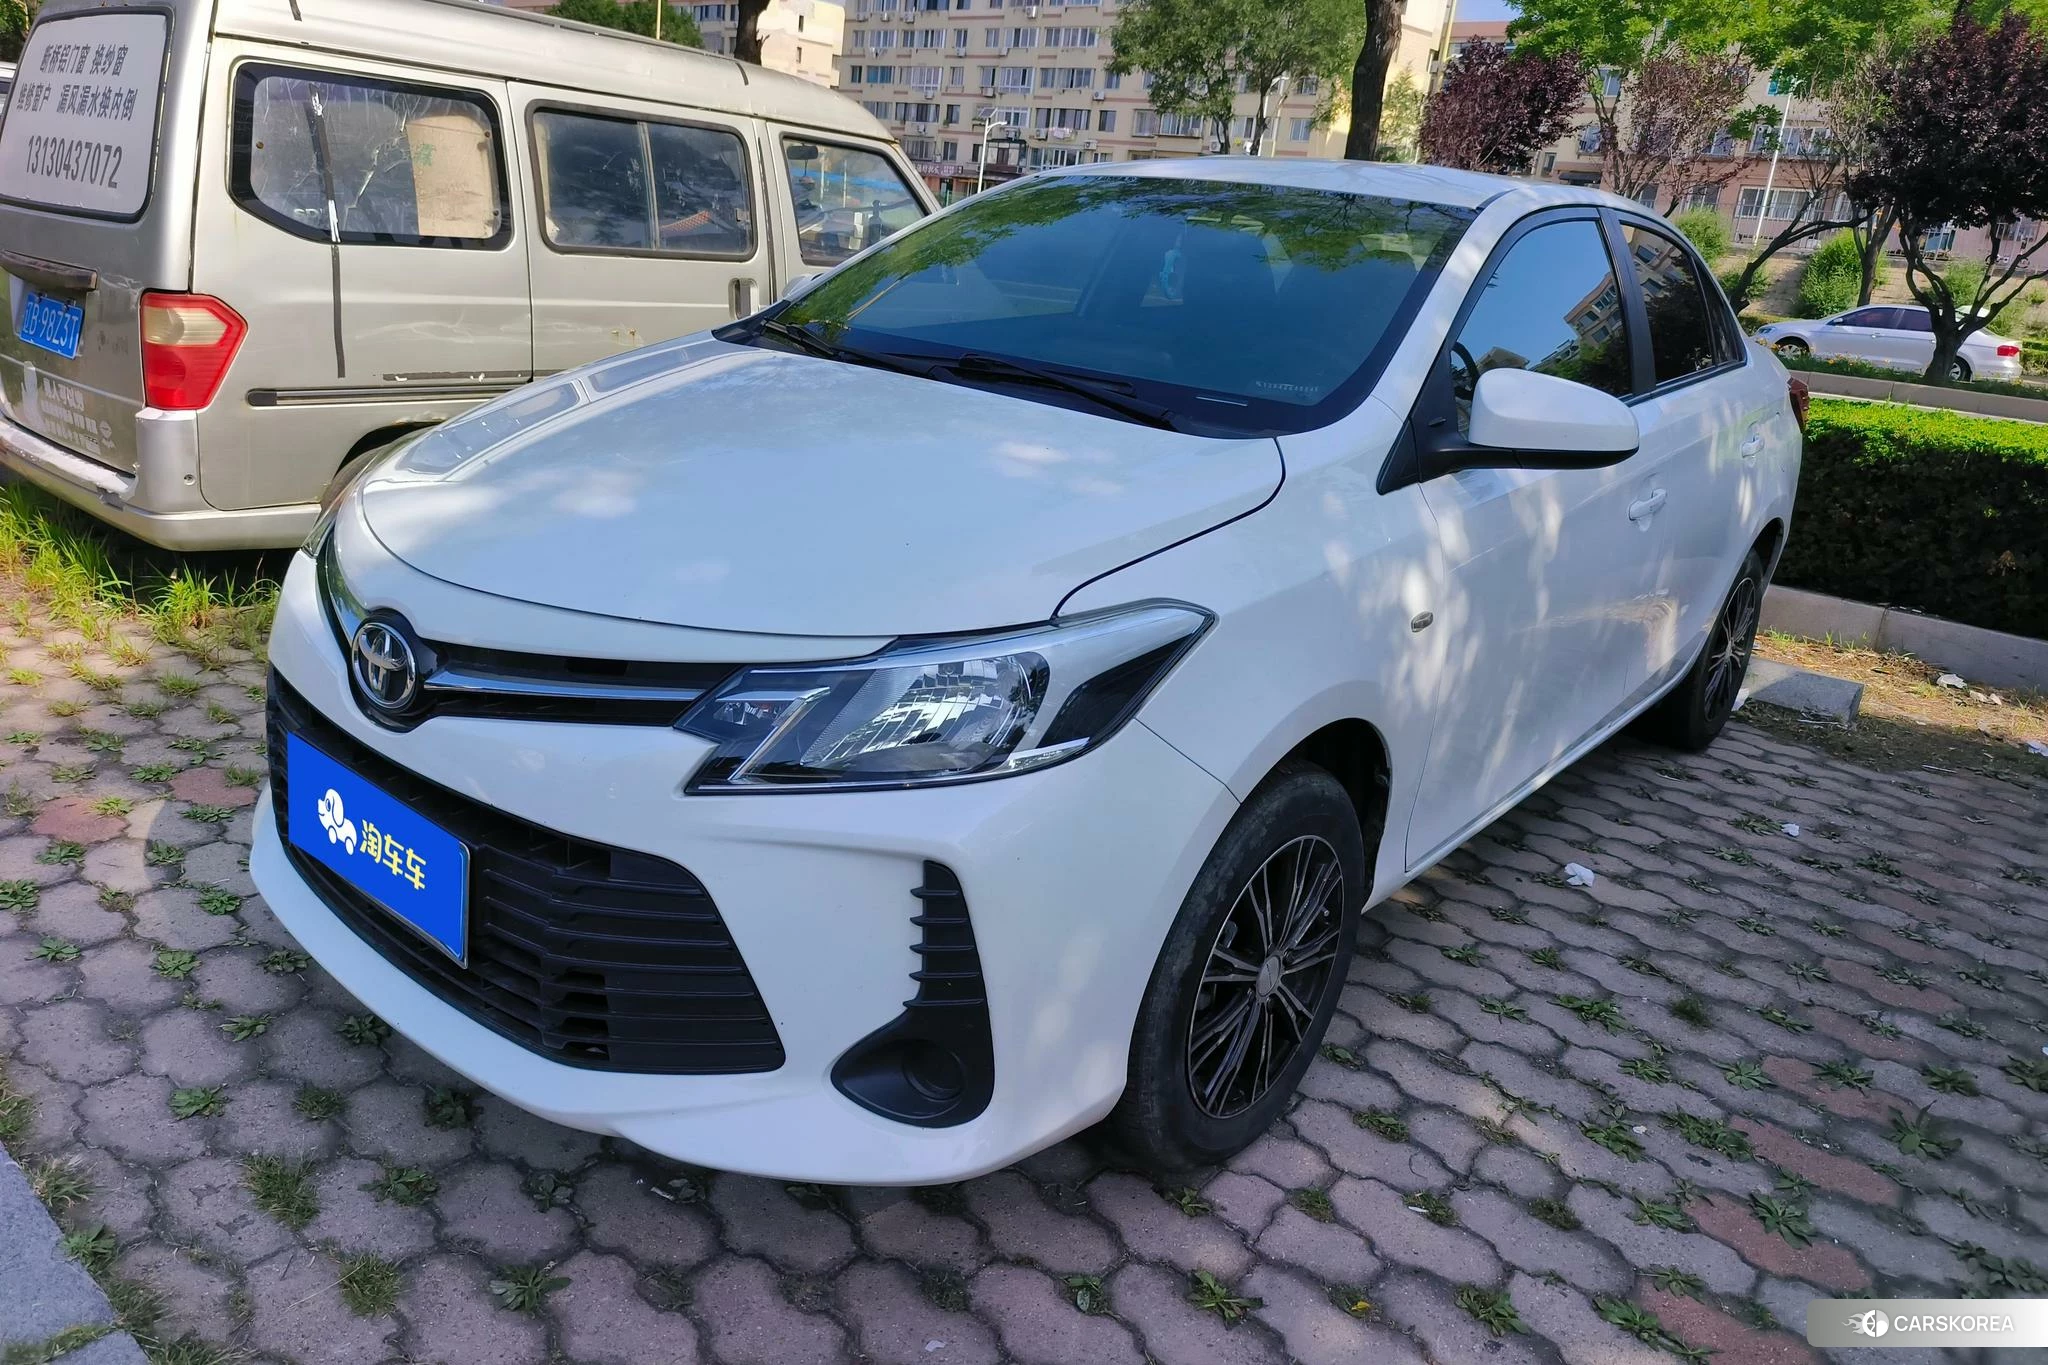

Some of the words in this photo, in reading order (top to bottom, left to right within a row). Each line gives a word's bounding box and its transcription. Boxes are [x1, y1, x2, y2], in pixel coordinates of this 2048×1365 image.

[40, 43, 91, 74] 断桥铝门窗
[90, 43, 129, 77] 换纱窗
[56, 84, 138, 121] 漏风漏水换内倒
[26, 135, 123, 189] 13130437072
